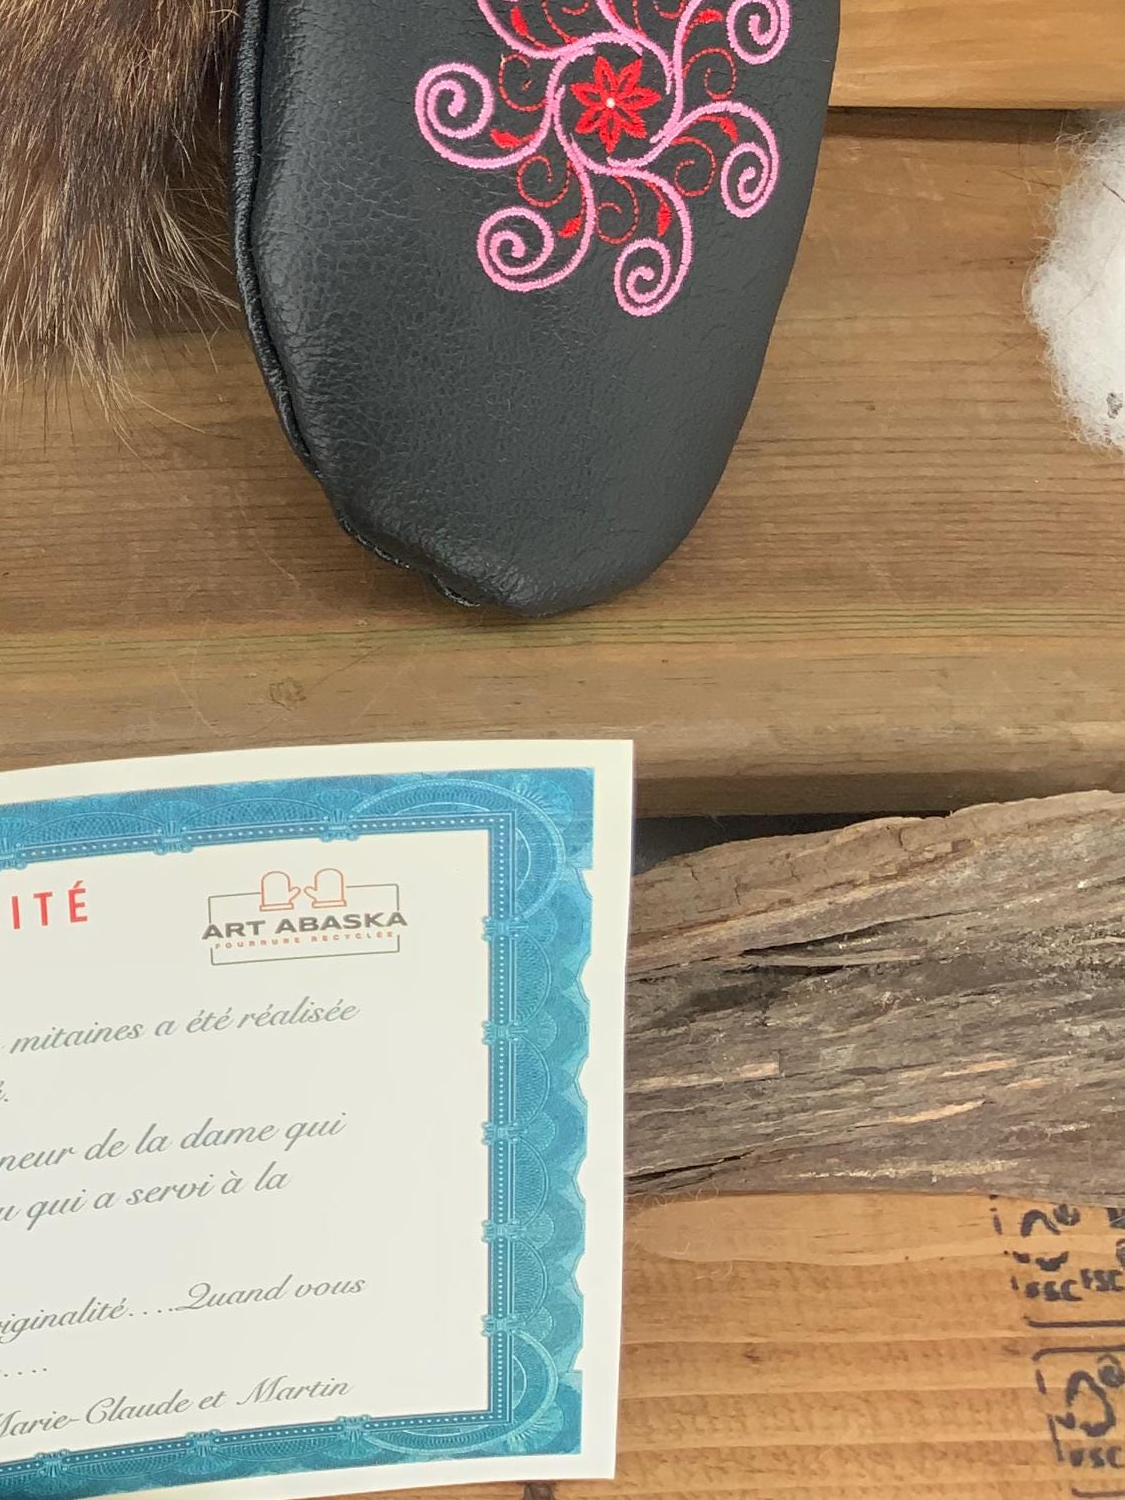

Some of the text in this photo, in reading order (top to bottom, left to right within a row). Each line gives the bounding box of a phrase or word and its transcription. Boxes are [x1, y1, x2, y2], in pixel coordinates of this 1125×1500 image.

[202, 912, 408, 940] ART ABASKA
[9, 1021, 145, 1055] mitaines
[154, 1018, 177, 1037] a
[186, 1006, 235, 1033] été
[237, 995, 361, 1029] réalisée
[84, 1128, 129, 1161] de
[134, 1122, 172, 1156] la
[180, 1117, 278, 1150] dame
[284, 1112, 347, 1151] qui
[26, 1188, 87, 1231] qui
[93, 1191, 118, 1209] a
[125, 1173, 215, 1206] servi
[220, 1169, 247, 1195] à
[254, 1161, 292, 1192] la
[294, 1278, 367, 1299] vous
[198, 1389, 229, 1411] et
[236, 1375, 356, 1408] Martin
